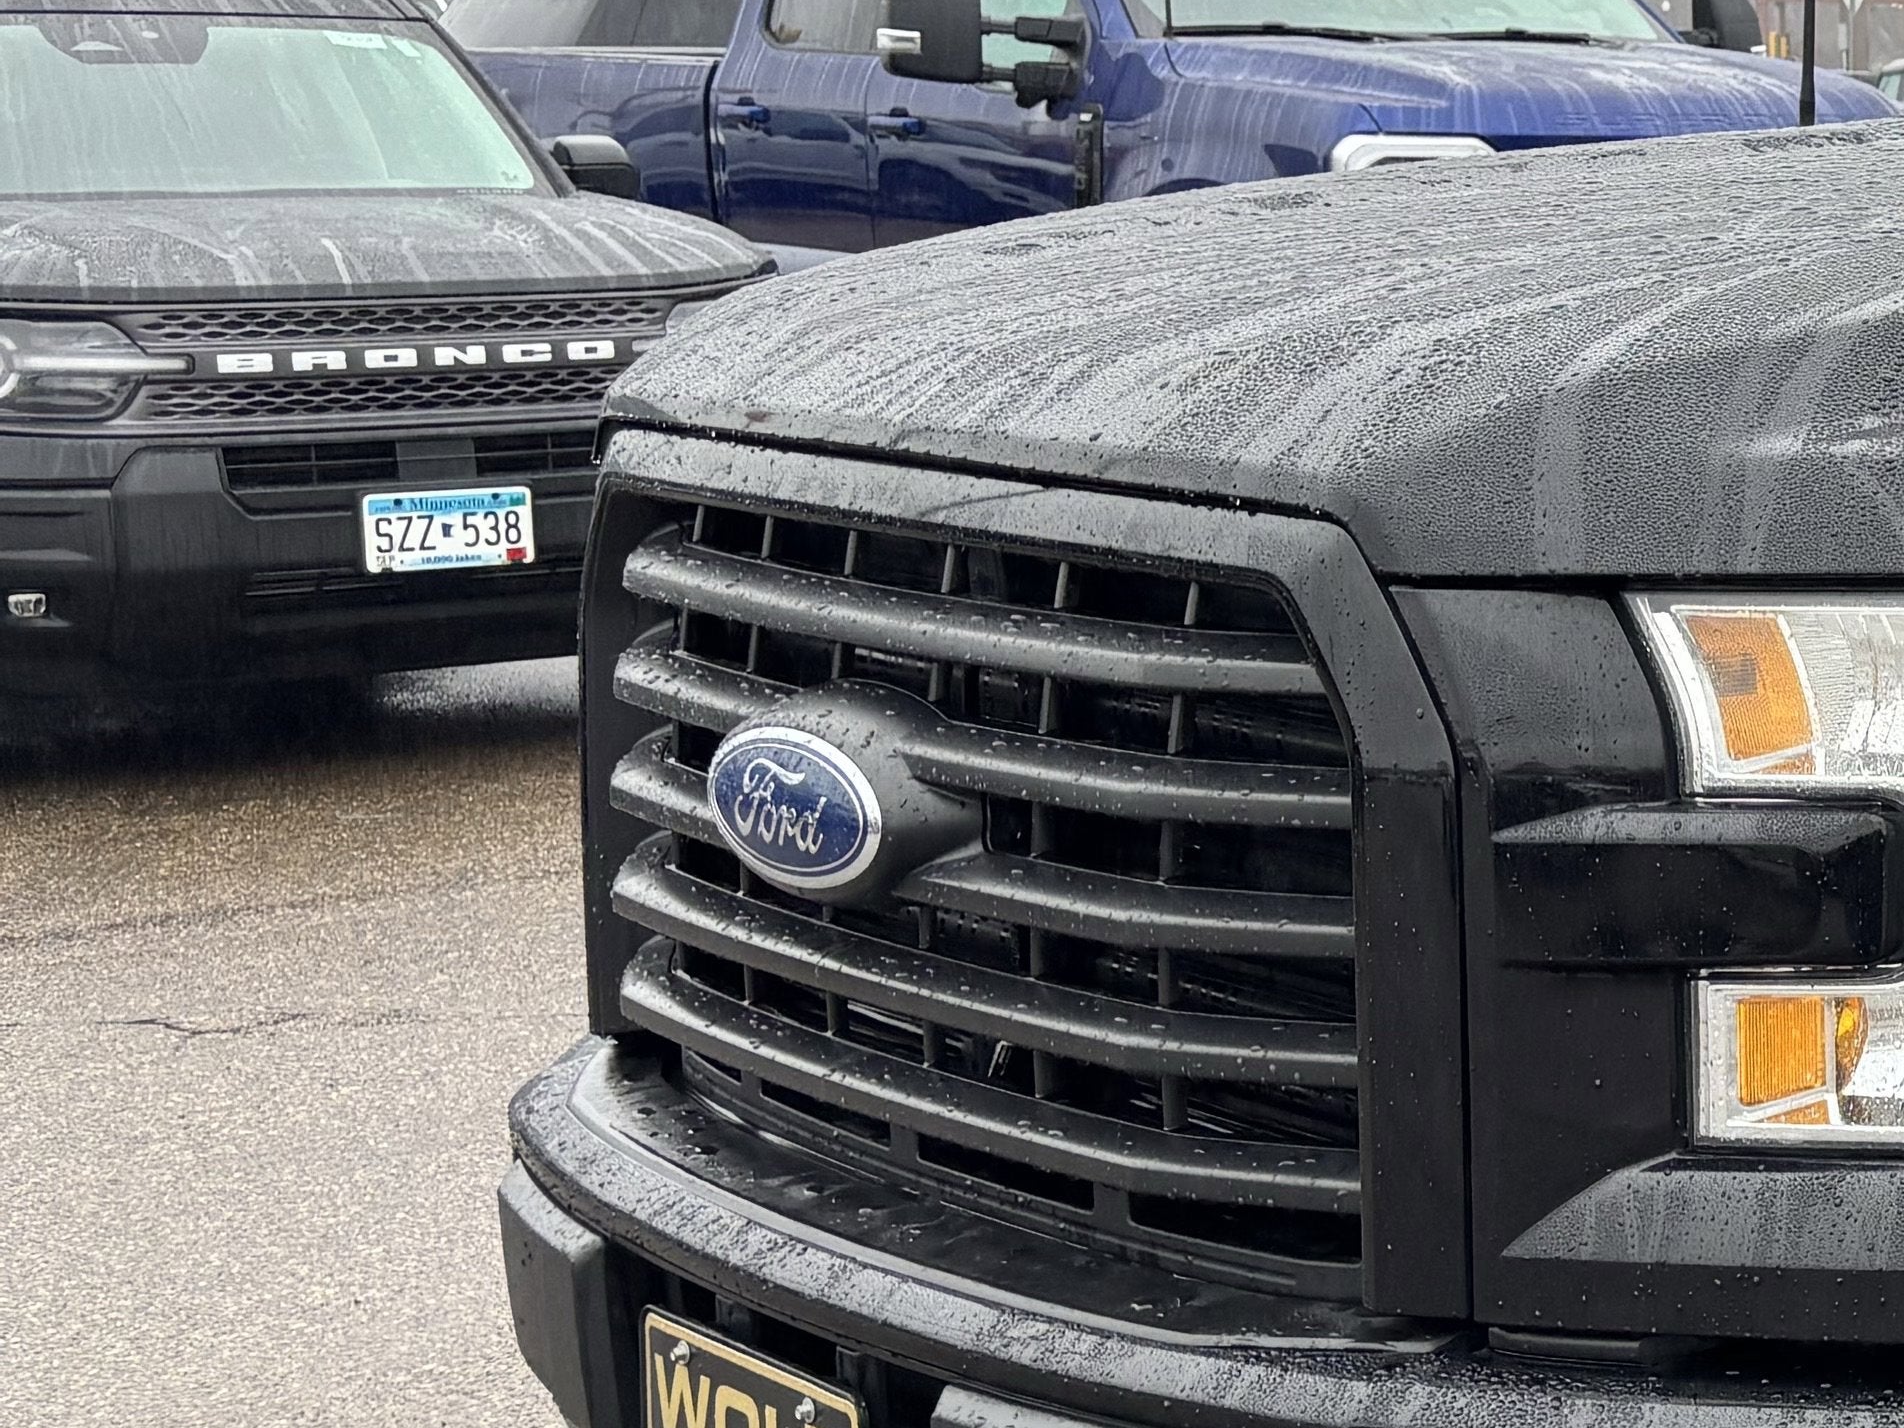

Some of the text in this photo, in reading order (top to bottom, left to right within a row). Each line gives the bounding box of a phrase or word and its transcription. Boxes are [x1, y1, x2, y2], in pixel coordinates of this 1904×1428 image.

[216, 340, 615, 373] BRONCO
[409, 496, 485, 512] Minnesota
[374, 510, 522, 553] SZZ 538
[732, 757, 829, 855] Ford
